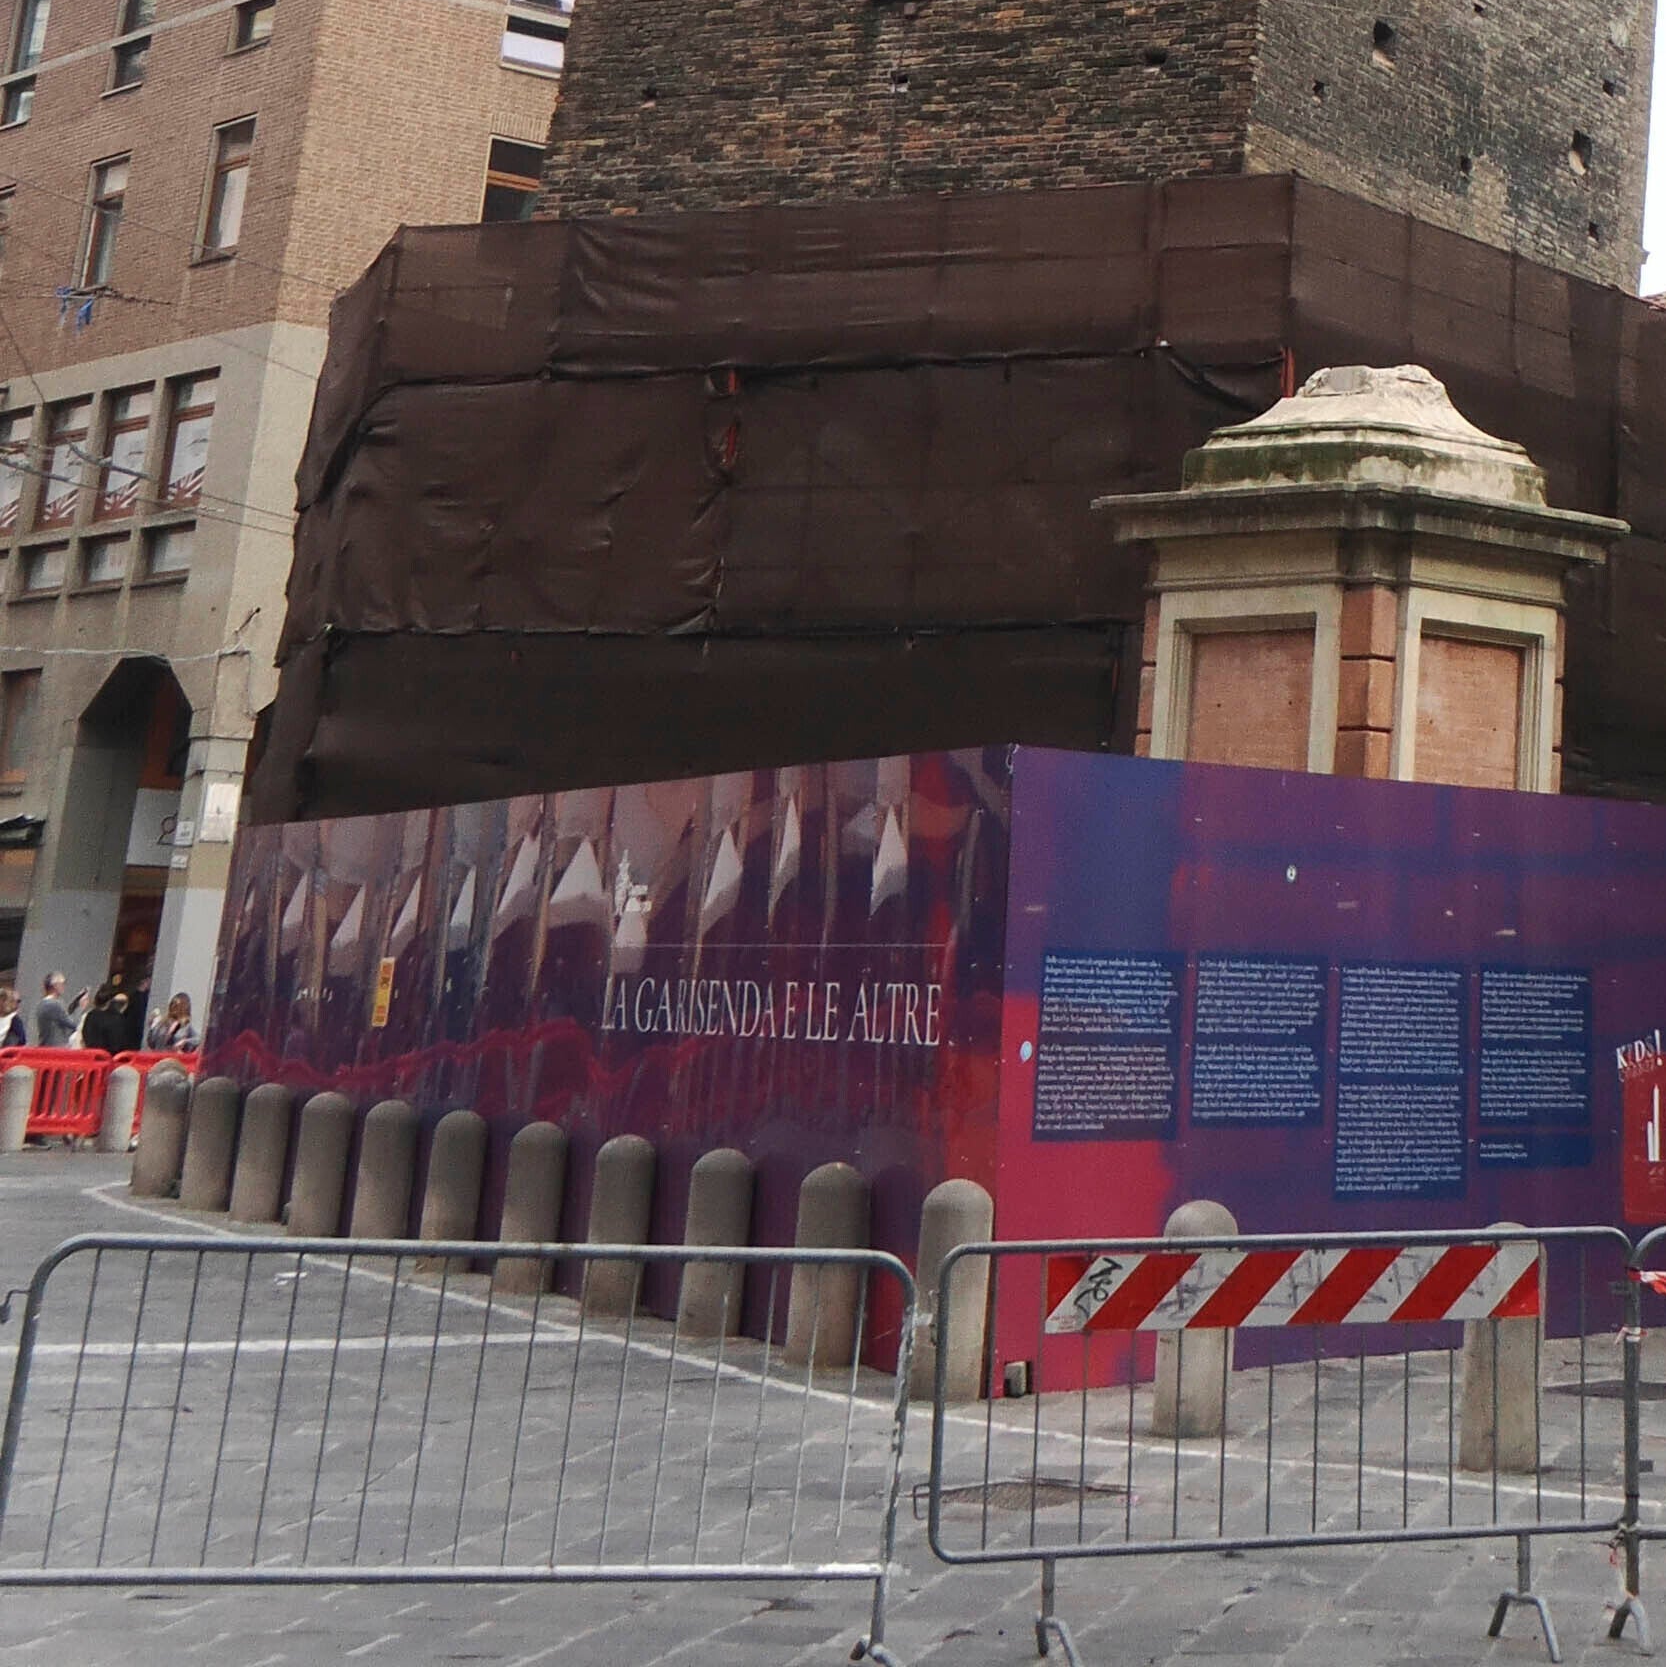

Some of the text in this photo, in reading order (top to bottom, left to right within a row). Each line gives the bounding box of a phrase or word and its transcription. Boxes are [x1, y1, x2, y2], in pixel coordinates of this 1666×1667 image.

[600, 977, 942, 1047] LA GARISENDA E LE ALTRE
[1615, 1028, 1663, 1069] KIDS!
